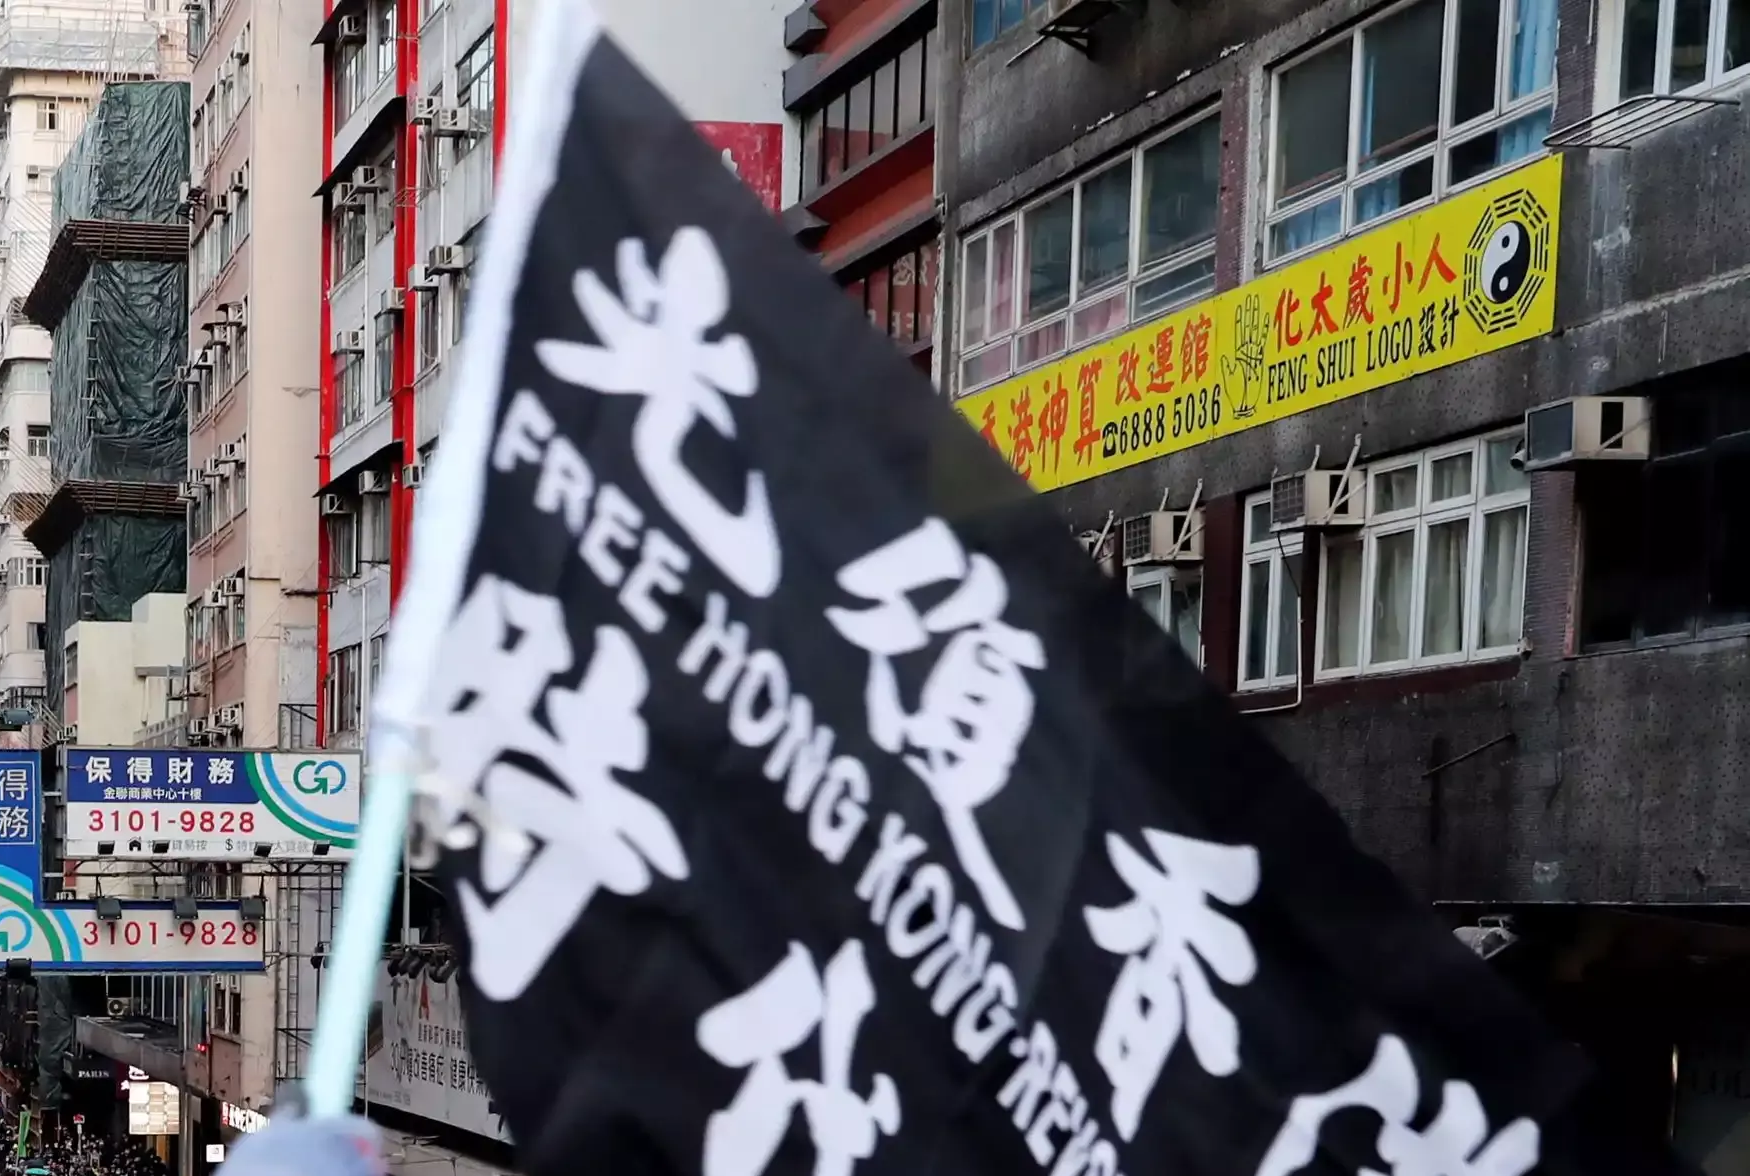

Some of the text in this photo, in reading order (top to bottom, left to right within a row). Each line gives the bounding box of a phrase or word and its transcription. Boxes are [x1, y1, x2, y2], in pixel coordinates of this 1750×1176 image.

[1116, 313, 1210, 404] 改運館
[1273, 234, 1456, 353] 化太歲小人
[1267, 297, 1460, 404] FENG SHUI LOGO 設計
[1120, 384, 1221, 453] 6888 5036
[494, 389, 691, 633] FREE
[677, 592, 870, 863] HONG
[85, 756, 234, 784] 保得財務
[89, 809, 254, 833] 3101-9828
[83, 921, 257, 946] 3101-9828
